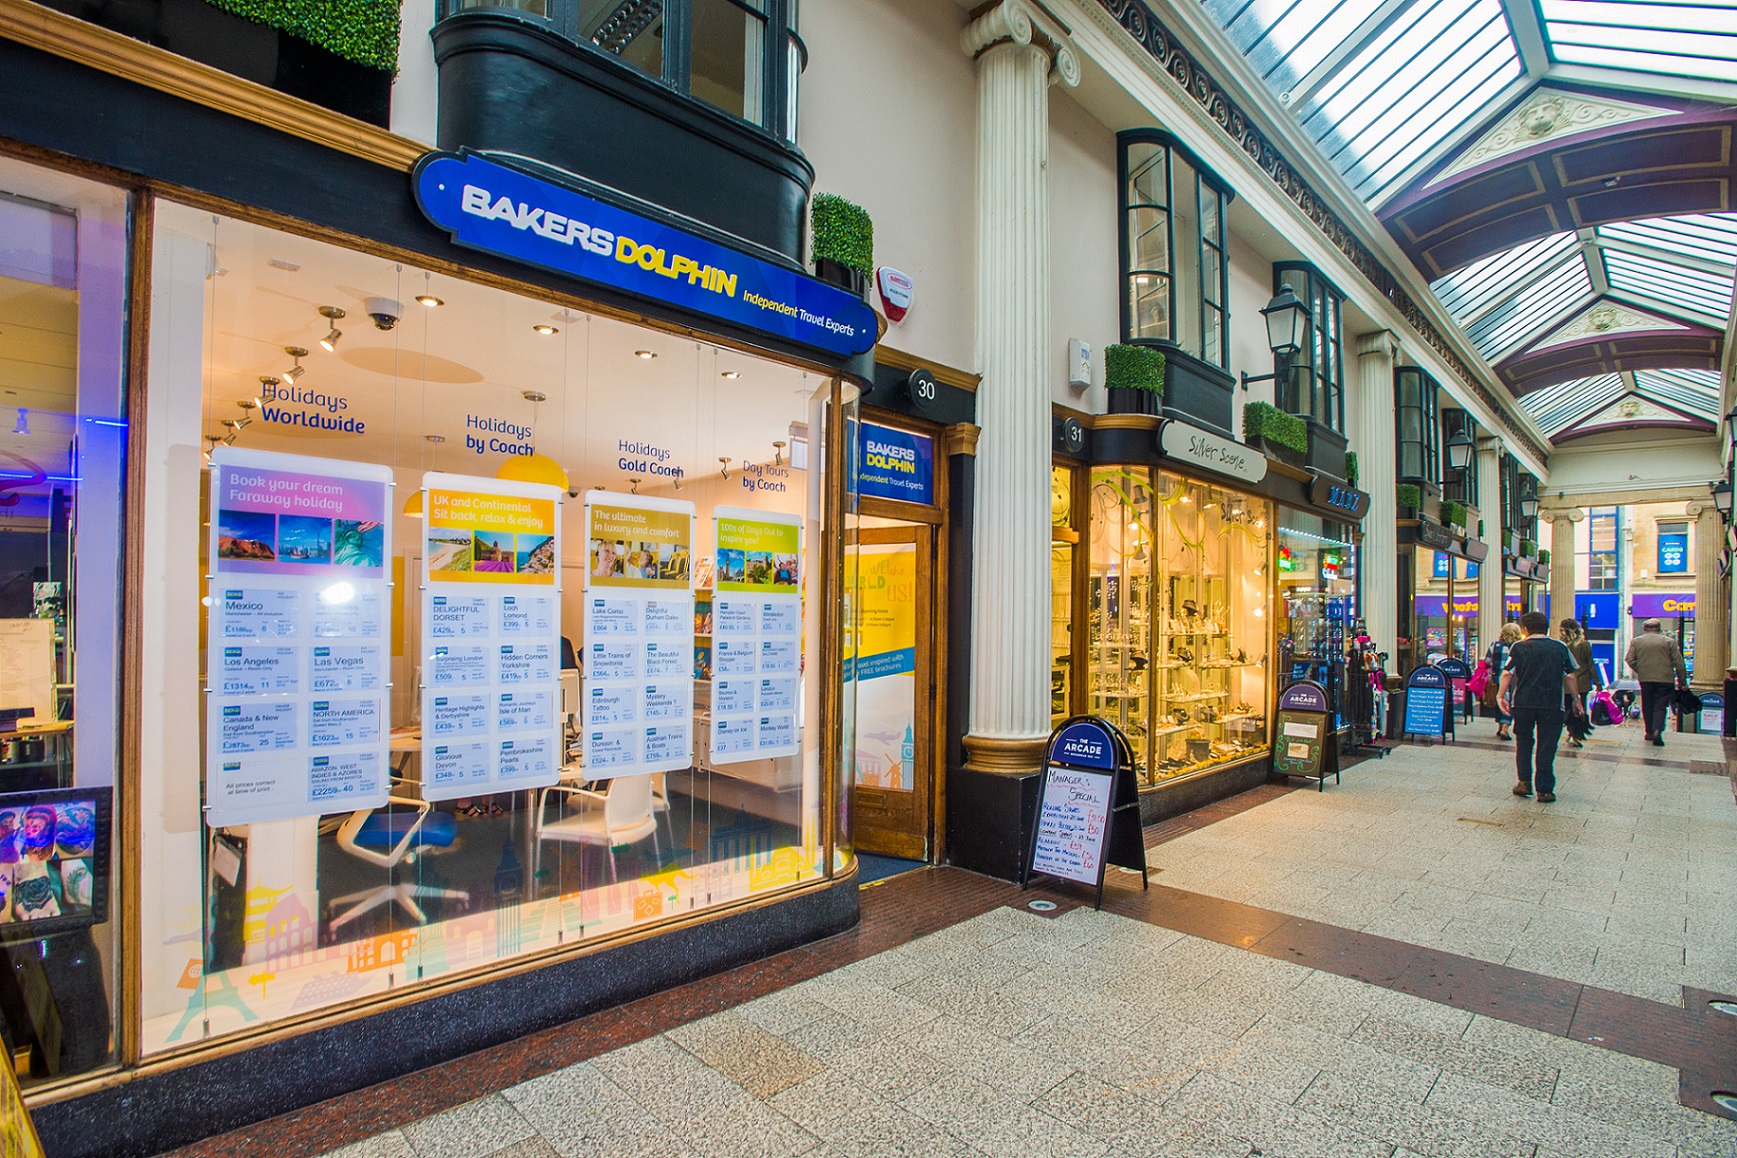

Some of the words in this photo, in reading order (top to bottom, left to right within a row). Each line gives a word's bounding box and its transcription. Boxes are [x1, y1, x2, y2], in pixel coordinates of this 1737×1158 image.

[461, 183, 615, 257] BAKERS
[613, 234, 738, 299] DOLPHIN
[742, 289, 799, 319] Independent
[798, 307, 824, 326] Travel
[825, 316, 855, 337] Experts
[262, 382, 348, 412] Holidays
[918, 380, 935, 400] 30
[261, 405, 365, 434] Worldwide
[466, 414, 532, 440] Holidays
[1070, 426, 1083, 443] 31
[465, 434, 485, 455] by
[489, 438, 533, 457] Coach
[618, 439, 671, 462] Holidays
[866, 440, 915, 461] BAKERS
[1188, 435, 1218, 461] Silver
[1219, 447, 1245, 471] Scene
[618, 457, 646, 472] Gold
[649, 462, 684, 478] Coach
[742, 460, 762, 477] Day
[765, 464, 789, 478] Tours
[866, 453, 915, 474] DOLPHIN
[230, 473, 265, 487] Book
[269, 479, 300, 492] your
[303, 481, 343, 496] dream
[742, 476, 755, 491] by
[757, 479, 786, 492] Coach
[860, 472, 889, 484] dependent
[889, 477, 905, 487] Travel
[905, 480, 924, 491] Experts
[230, 489, 292, 509] Faraway
[294, 494, 343, 513] holiday
[434, 495, 449, 506] UK
[451, 497, 470, 508] and
[472, 498, 532, 513] Continental
[434, 508, 448, 519] Sit
[451, 510, 478, 523] back,
[480, 512, 506, 524] relax
[508, 514, 517, 524] &
[517, 516, 543, 530] enjoy
[594, 510, 610, 520] The
[611, 512, 647, 524] ultimate
[594, 521, 603, 531] in
[604, 523, 631, 536] luxury
[633, 526, 648, 535] and
[649, 528, 680, 538] comfort
[721, 524, 737, 532] 100s
[738, 525, 745, 535] of
[746, 525, 763, 536] Days
[764, 528, 775, 536] Out
[776, 528, 784, 536] to
[721, 534, 743, 544] inspire
[744, 537, 759, 546] you!
[225, 601, 263, 611] Mexico
[433, 606, 480, 614] DELIGHTFUL
[1663, 599, 1696, 612] Car
[433, 614, 465, 622] DORSET
[224, 658, 241, 666] Los
[243, 657, 280, 667] Angeles
[314, 658, 332, 666] Las
[334, 657, 364, 666] Vegas
[870, 657, 891, 667] inspired
[892, 653, 904, 662] with
[860, 668, 874, 676] FREE
[875, 664, 902, 674] brochures
[646, 699, 672, 707] Weekends
[1289, 696, 1317, 704] ARCADE
[313, 710, 340, 718] NORTH
[341, 709, 375, 717] AMERICA
[459, 704, 485, 712] Highlights
[223, 716, 253, 724] Canada
[441, 712, 470, 720] Derbyshire
[223, 723, 255, 732] England
[500, 747, 543, 756] Pembrokeshire
[1064, 742, 1102, 756] ARCADE
[435, 753, 462, 761] Glorious
[338, 768, 363, 776] AZORES
[435, 761, 457, 769] Devon
[1068, 787, 1100, 804] SPECIAL
